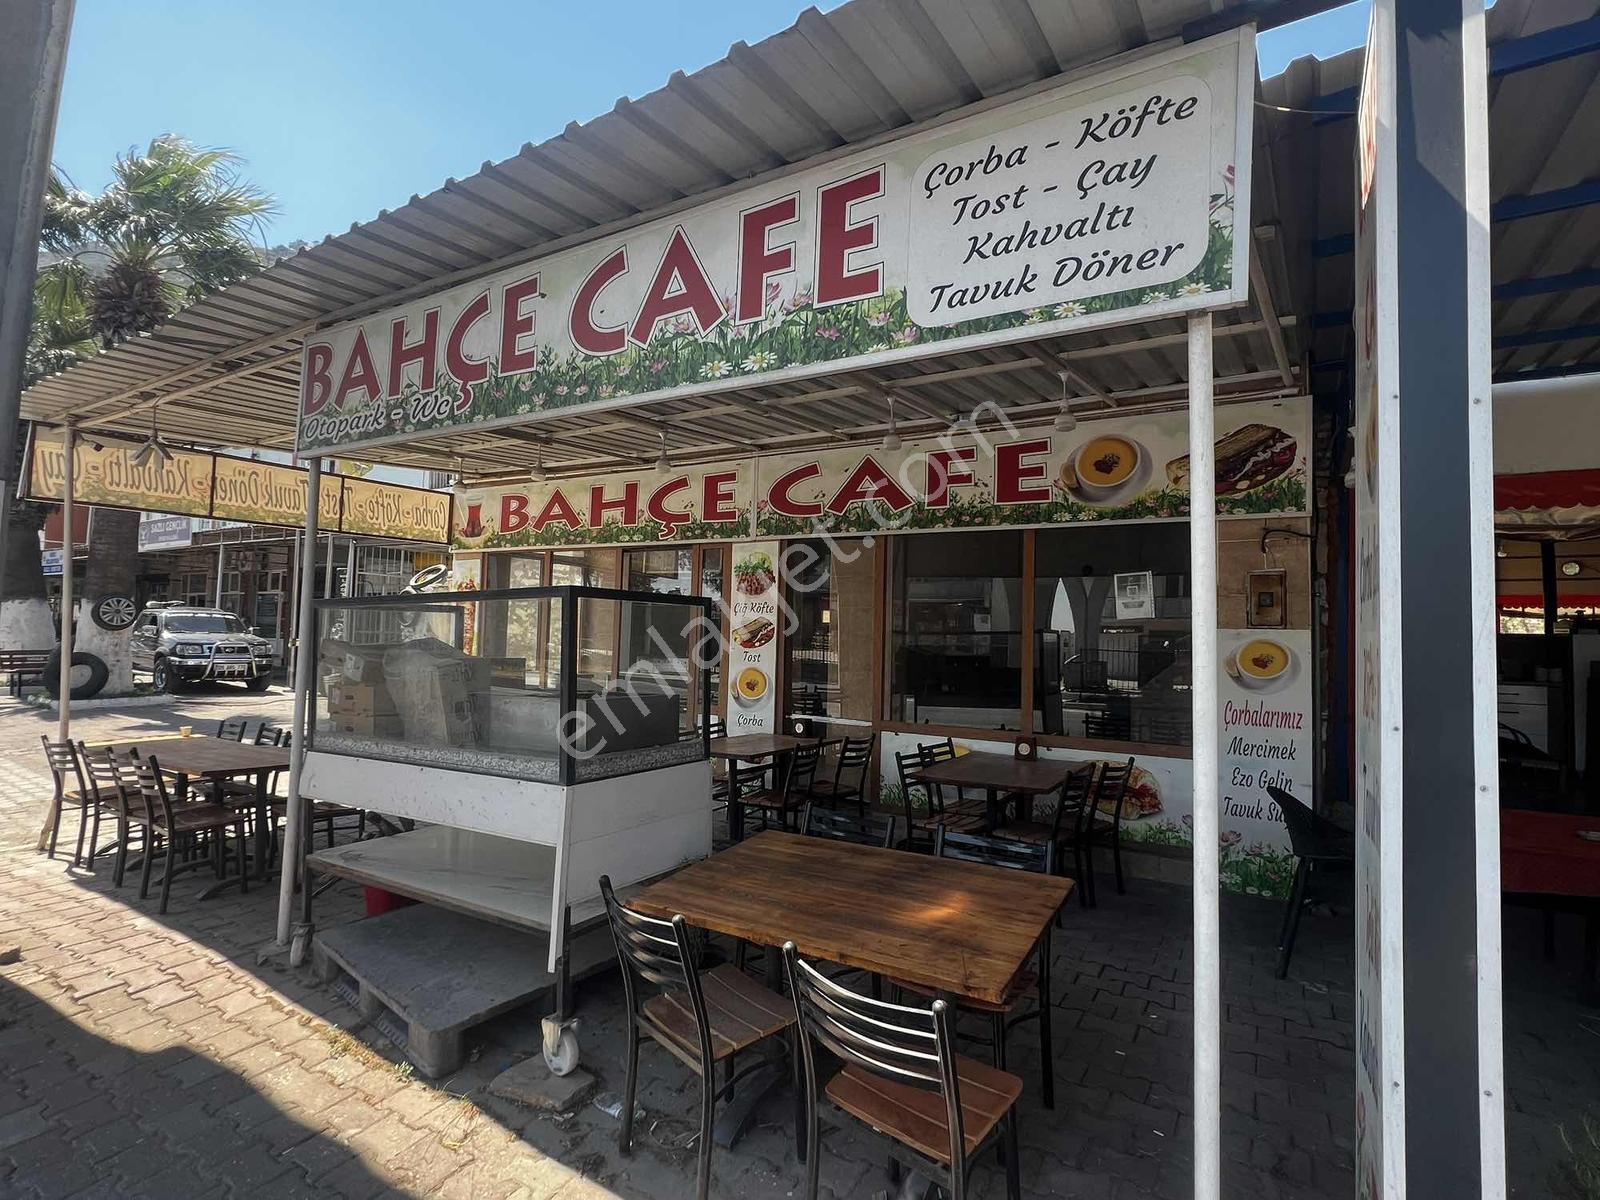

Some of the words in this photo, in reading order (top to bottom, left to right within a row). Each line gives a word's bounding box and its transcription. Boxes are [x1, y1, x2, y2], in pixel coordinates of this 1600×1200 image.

[924, 145, 1028, 198] Çorba
[1074, 95, 1198, 149] Köfte
[952, 185, 1029, 226] Tost
[1077, 154, 1158, 200] Çay
[963, 202, 1135, 264] Kahvaltı
[302, 271, 541, 418] BAHÇE
[568, 164, 886, 356] CAFE
[930, 264, 1038, 313] Tavuk
[1053, 242, 1184, 287] Döner
[305, 404, 385, 440] Otopark
[500, 470, 739, 540] BAHÇE
[767, 437, 1053, 517] CAFE
[733, 602, 748, 616] Çiğ
[750, 601, 775, 614] Köfte
[743, 651, 761, 663] Tost
[737, 713, 763, 727] Çorba
[1223, 699, 1304, 732] Çorbalarımız
[1227, 736, 1297, 760] Mercimek
[1231, 767, 1253, 788] Ezo
[1258, 769, 1293, 792] Gelin
[1223, 796, 1262, 820] Tavuk
[1267, 801, 1287, 824] Su
